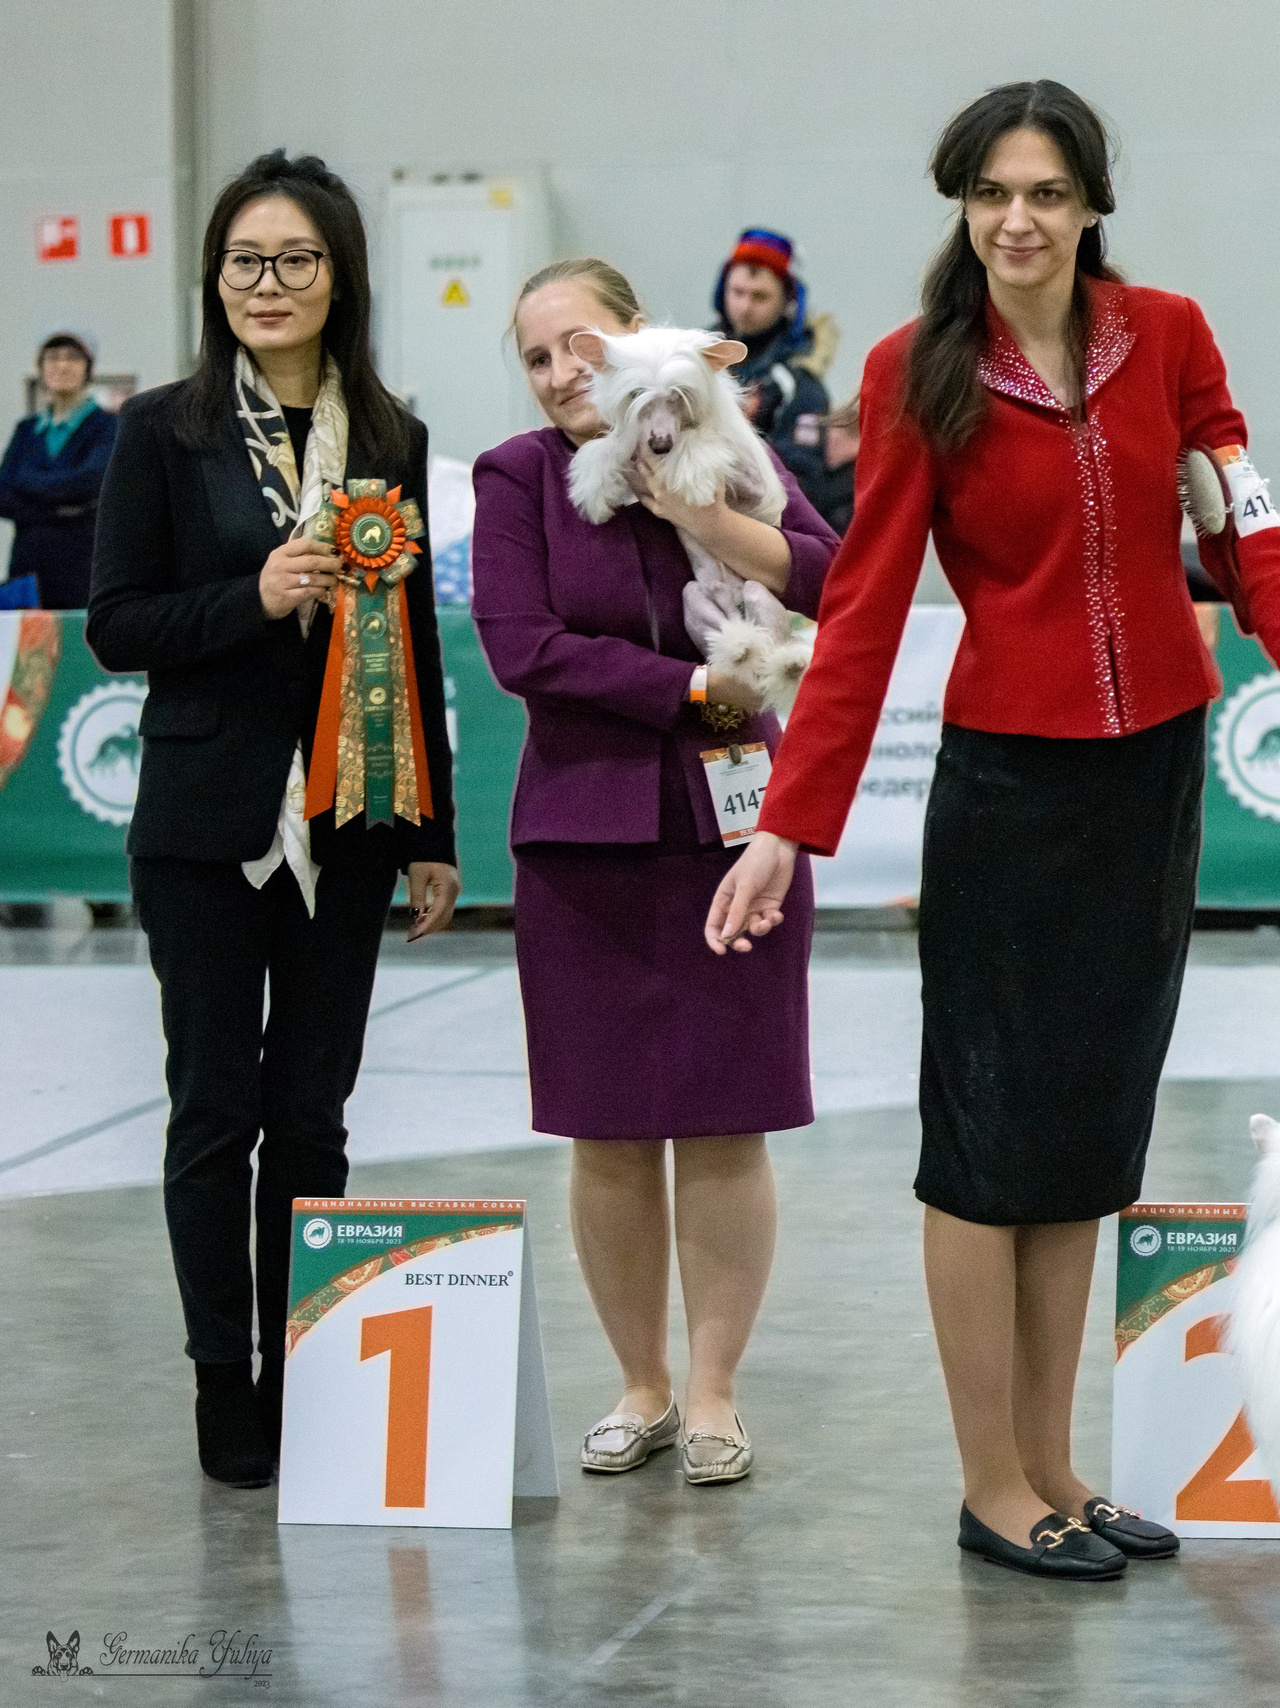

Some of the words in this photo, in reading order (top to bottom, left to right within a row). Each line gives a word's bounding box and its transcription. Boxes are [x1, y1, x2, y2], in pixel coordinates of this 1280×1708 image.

[1243, 494, 1277, 518] 41
[304, 1200, 404, 1208] НАЦИОНАЛЬНЫЕ
[1131, 1206, 1238, 1215] НАЦИОНАЛЬНЫЕ
[337, 1224, 403, 1238] ЕВРАЗИЯ
[1166, 1232, 1237, 1245] ЕВРАЗИЯ
[405, 1273, 445, 1286] BEST
[360, 1305, 433, 1508] 1
